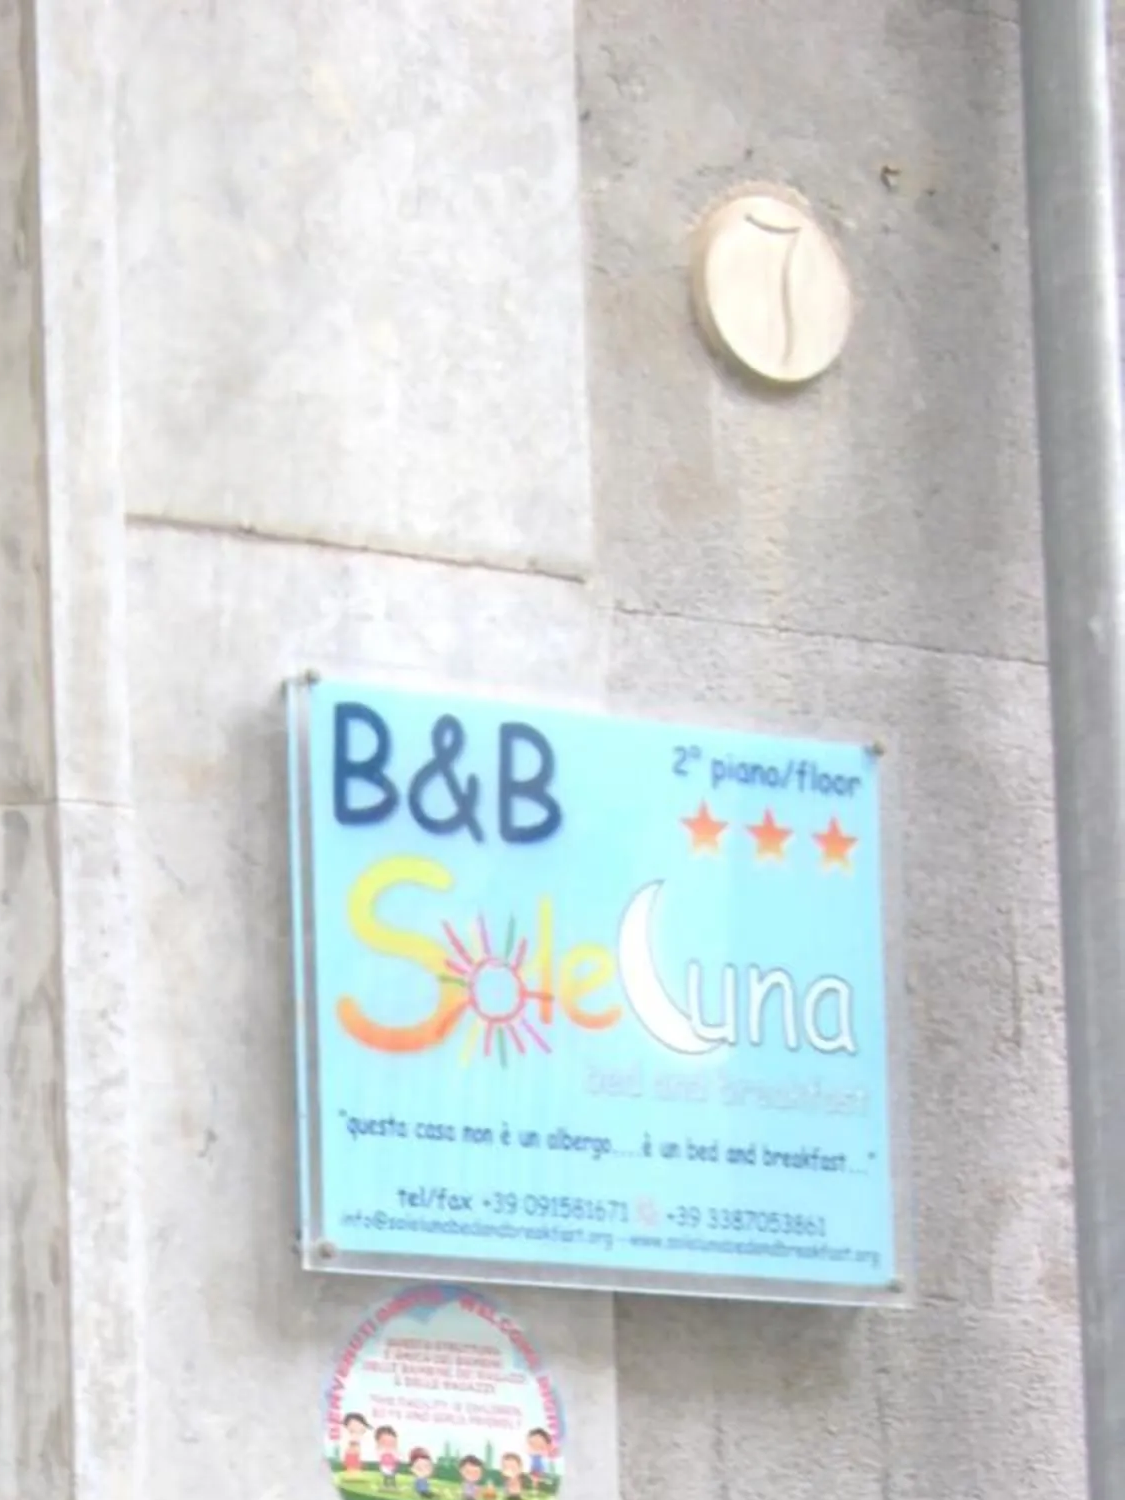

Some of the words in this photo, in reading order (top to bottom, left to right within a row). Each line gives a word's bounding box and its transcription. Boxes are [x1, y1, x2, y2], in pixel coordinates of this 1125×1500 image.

[741, 211, 803, 369] 7
[333, 701, 563, 845] B&B
[710, 752, 863, 798] piano/floor
[415, 1121, 457, 1143] casa
[685, 1135, 719, 1163] bed
[725, 1140, 757, 1167] and
[396, 1185, 473, 1211] tel/fax
